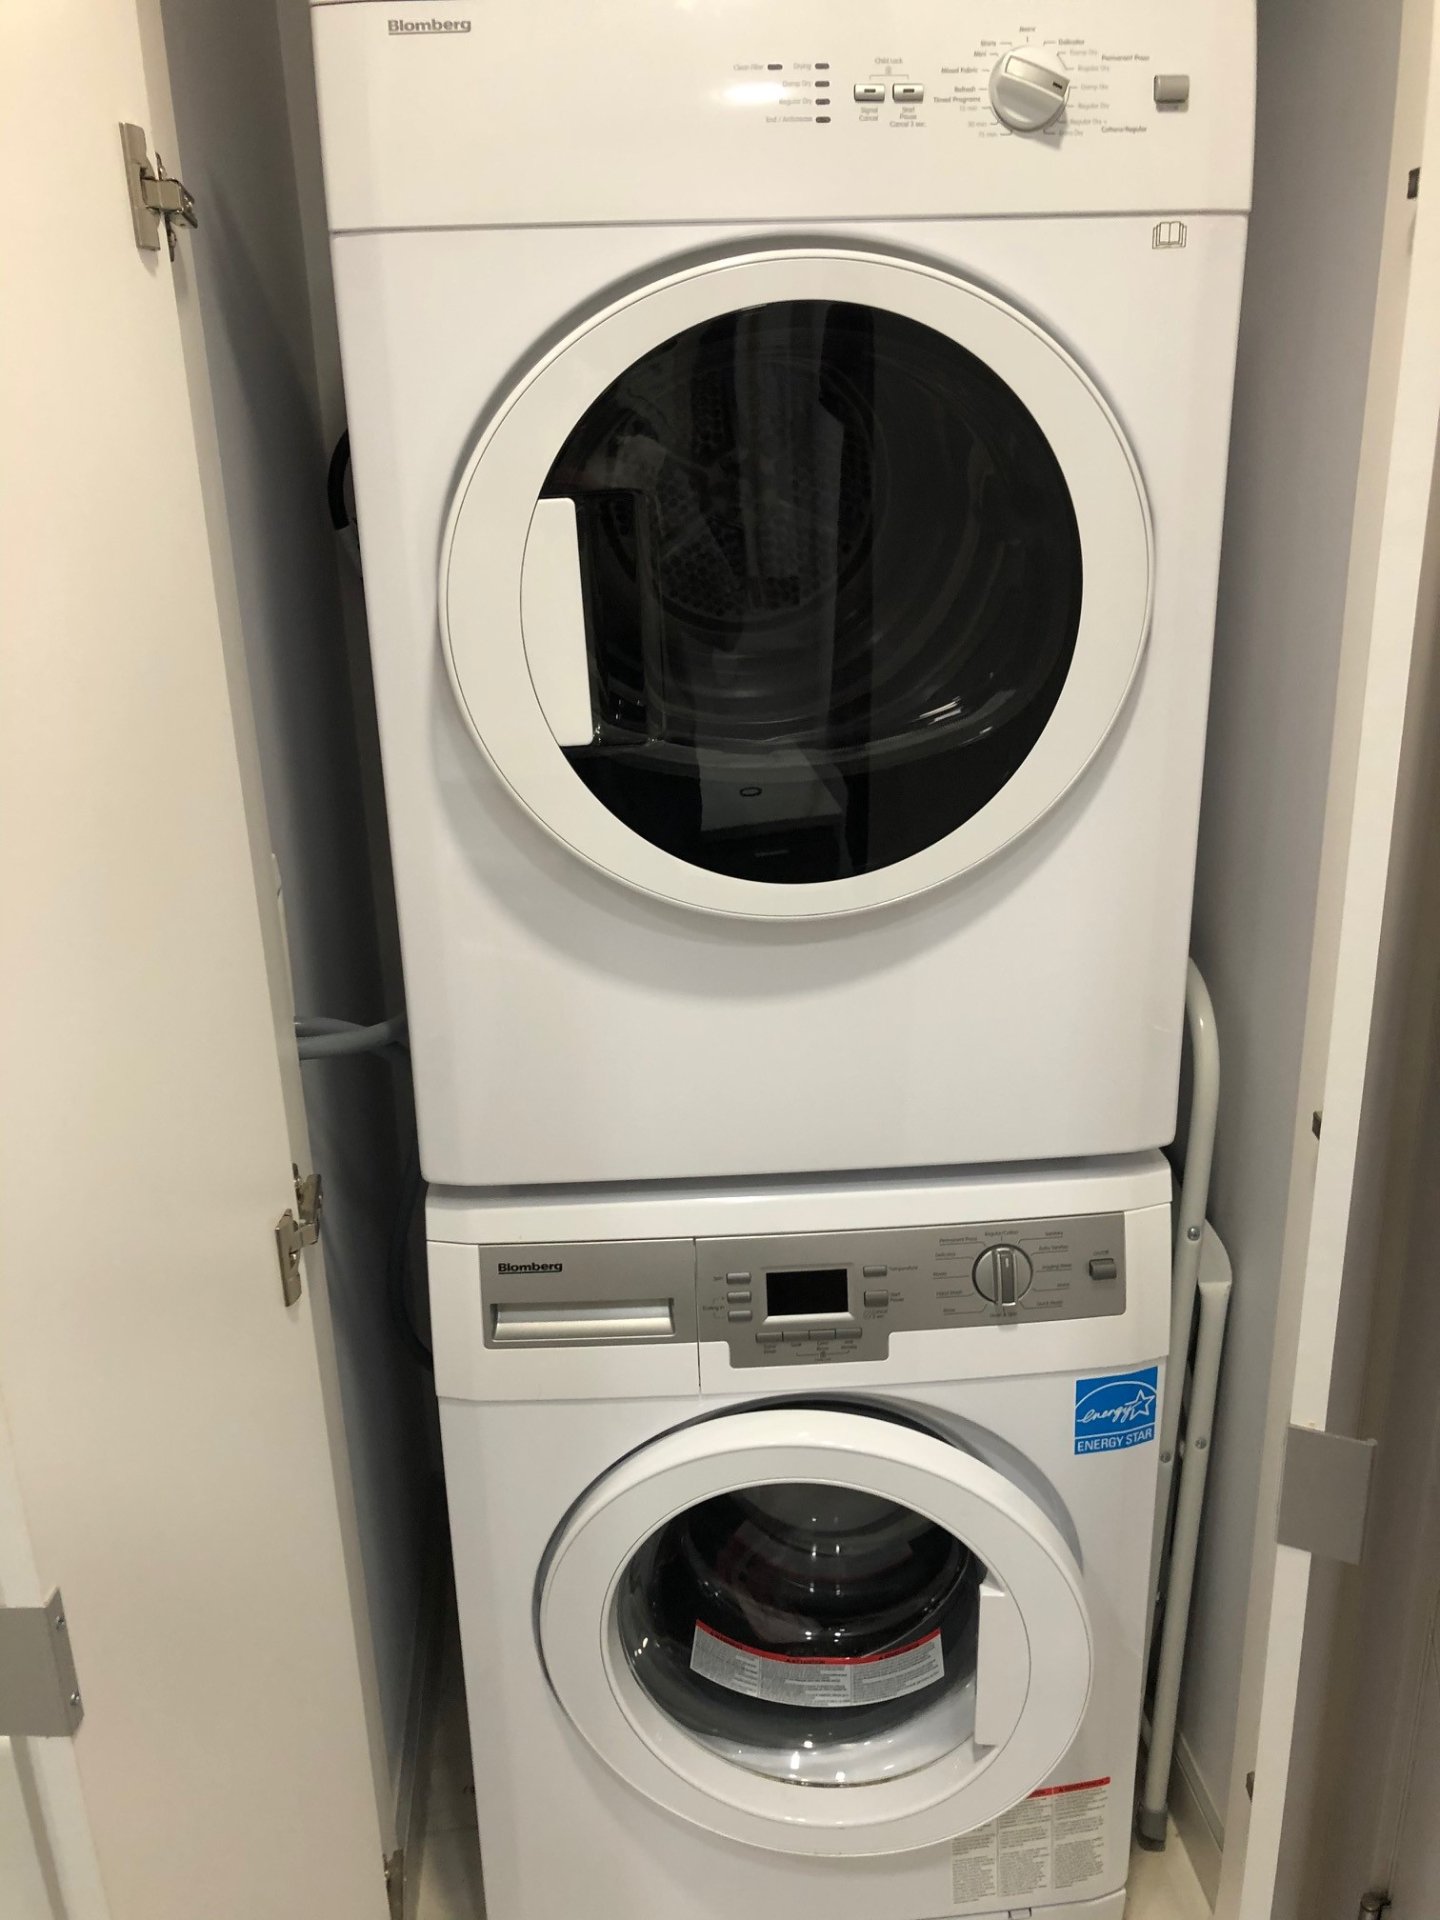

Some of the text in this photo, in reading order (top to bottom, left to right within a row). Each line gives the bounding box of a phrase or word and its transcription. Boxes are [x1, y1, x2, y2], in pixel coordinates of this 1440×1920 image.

[387, 18, 472, 35] Blomberg
[498, 1262, 563, 1275] Blomberg
[1077, 1428, 1152, 1452] ENERGY STAR
